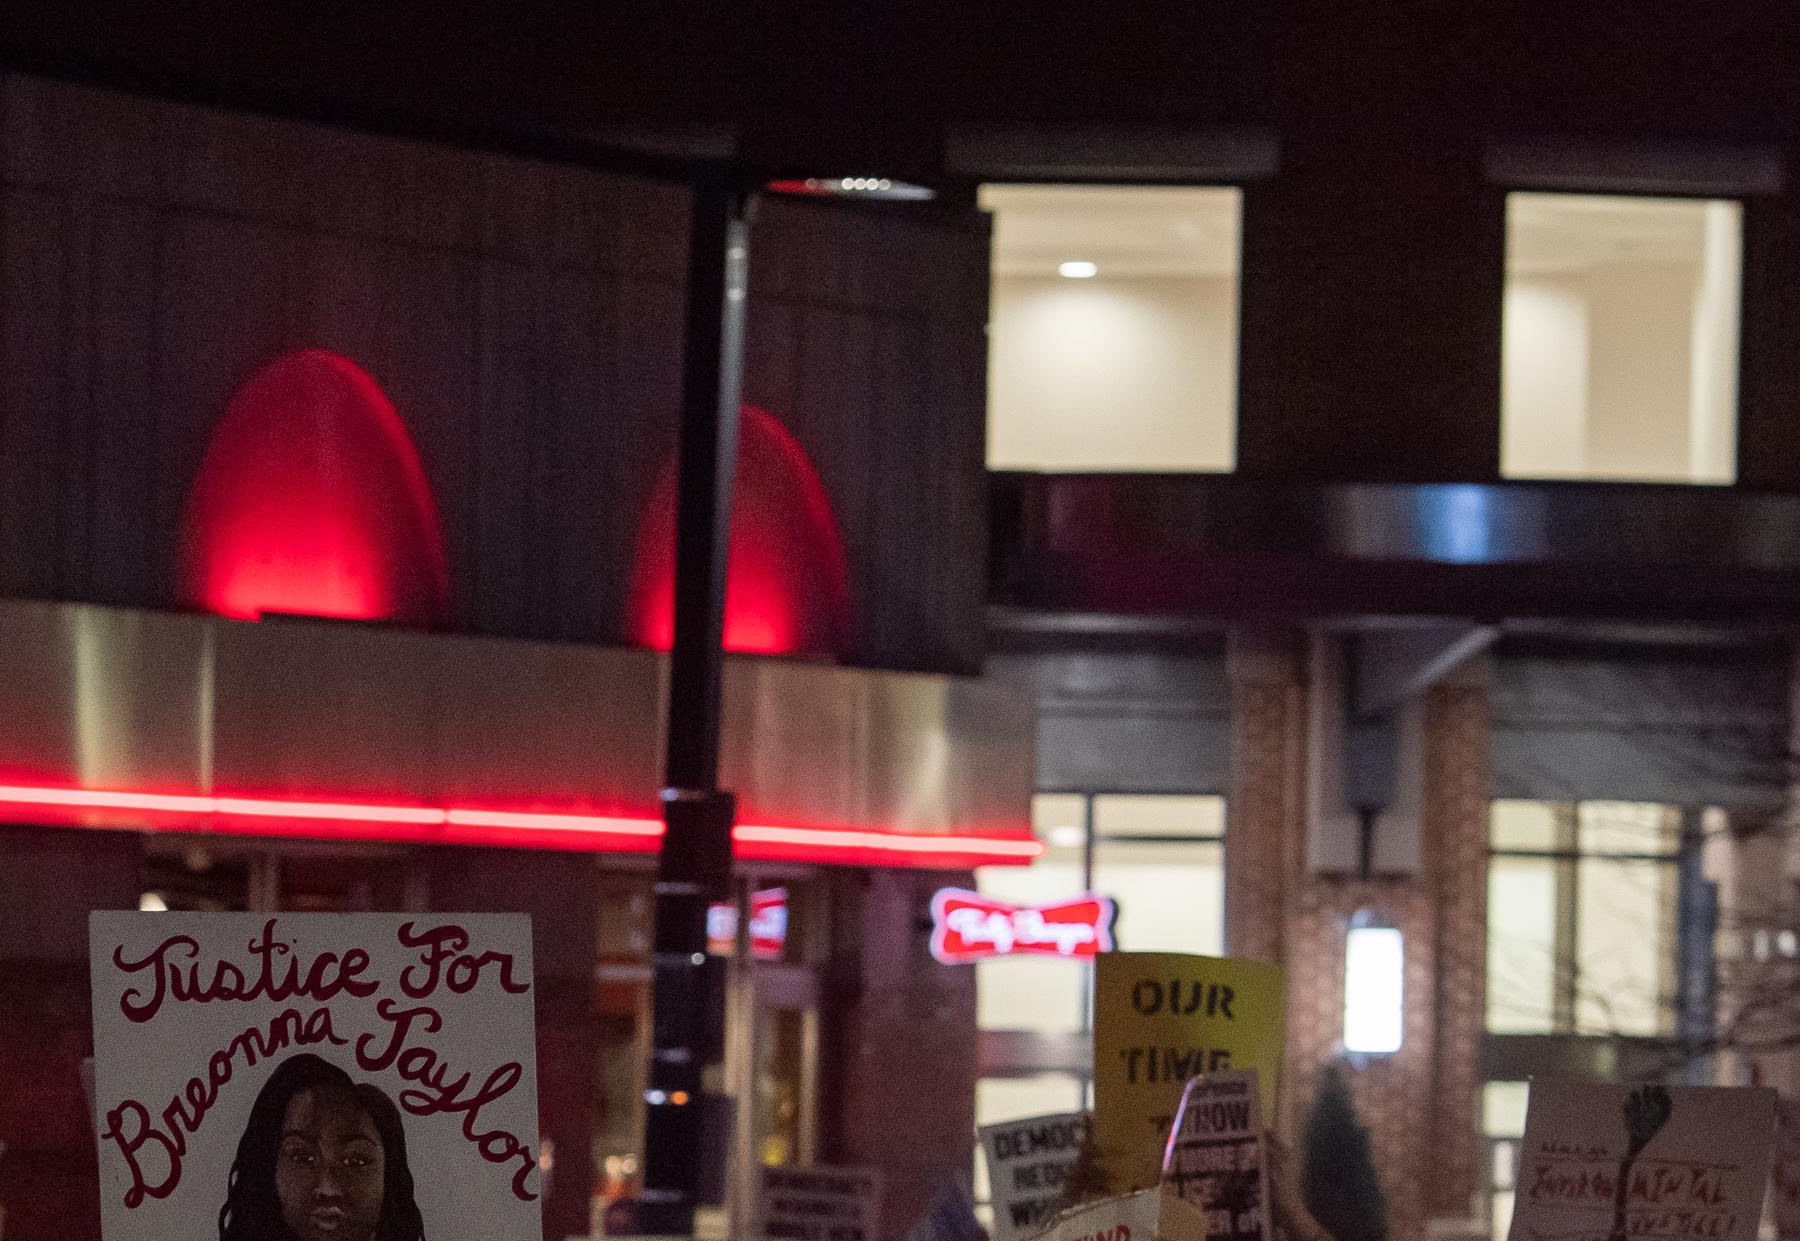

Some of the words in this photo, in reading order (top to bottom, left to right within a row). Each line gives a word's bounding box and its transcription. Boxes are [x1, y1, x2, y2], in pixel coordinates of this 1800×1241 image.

[113, 919, 379, 1022] Justice
[398, 921, 530, 999] For
[1130, 977, 1237, 1020] OUR
[101, 1006, 349, 1209] Breonna
[355, 998, 539, 1201] Taylor
[994, 1121, 1087, 1161] DEMOC
